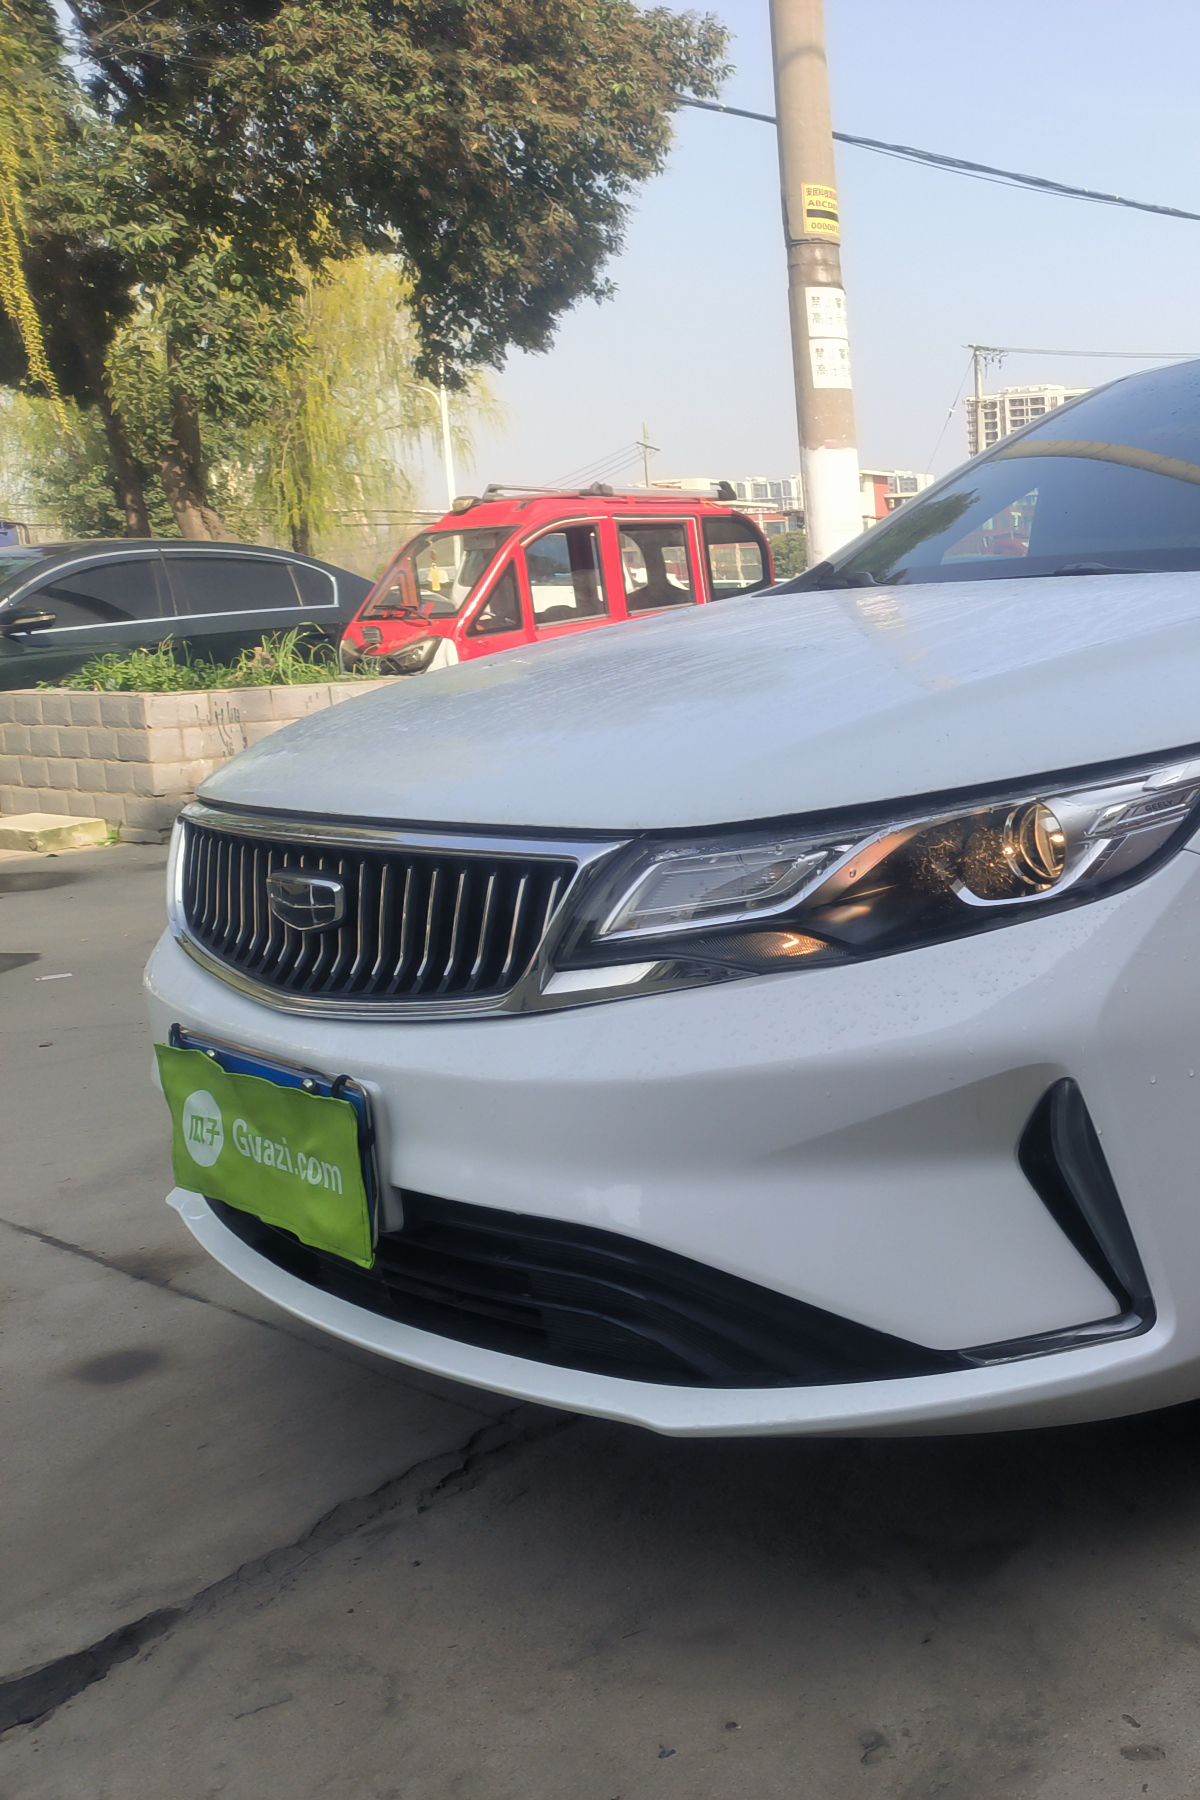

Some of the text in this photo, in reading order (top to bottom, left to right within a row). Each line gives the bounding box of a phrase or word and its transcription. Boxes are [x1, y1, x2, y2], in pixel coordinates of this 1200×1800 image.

[1145, 799, 1173, 812] GEELY
[188, 1114, 221, 1147] 瓜子
[232, 1118, 343, 1195] Guazi.com
